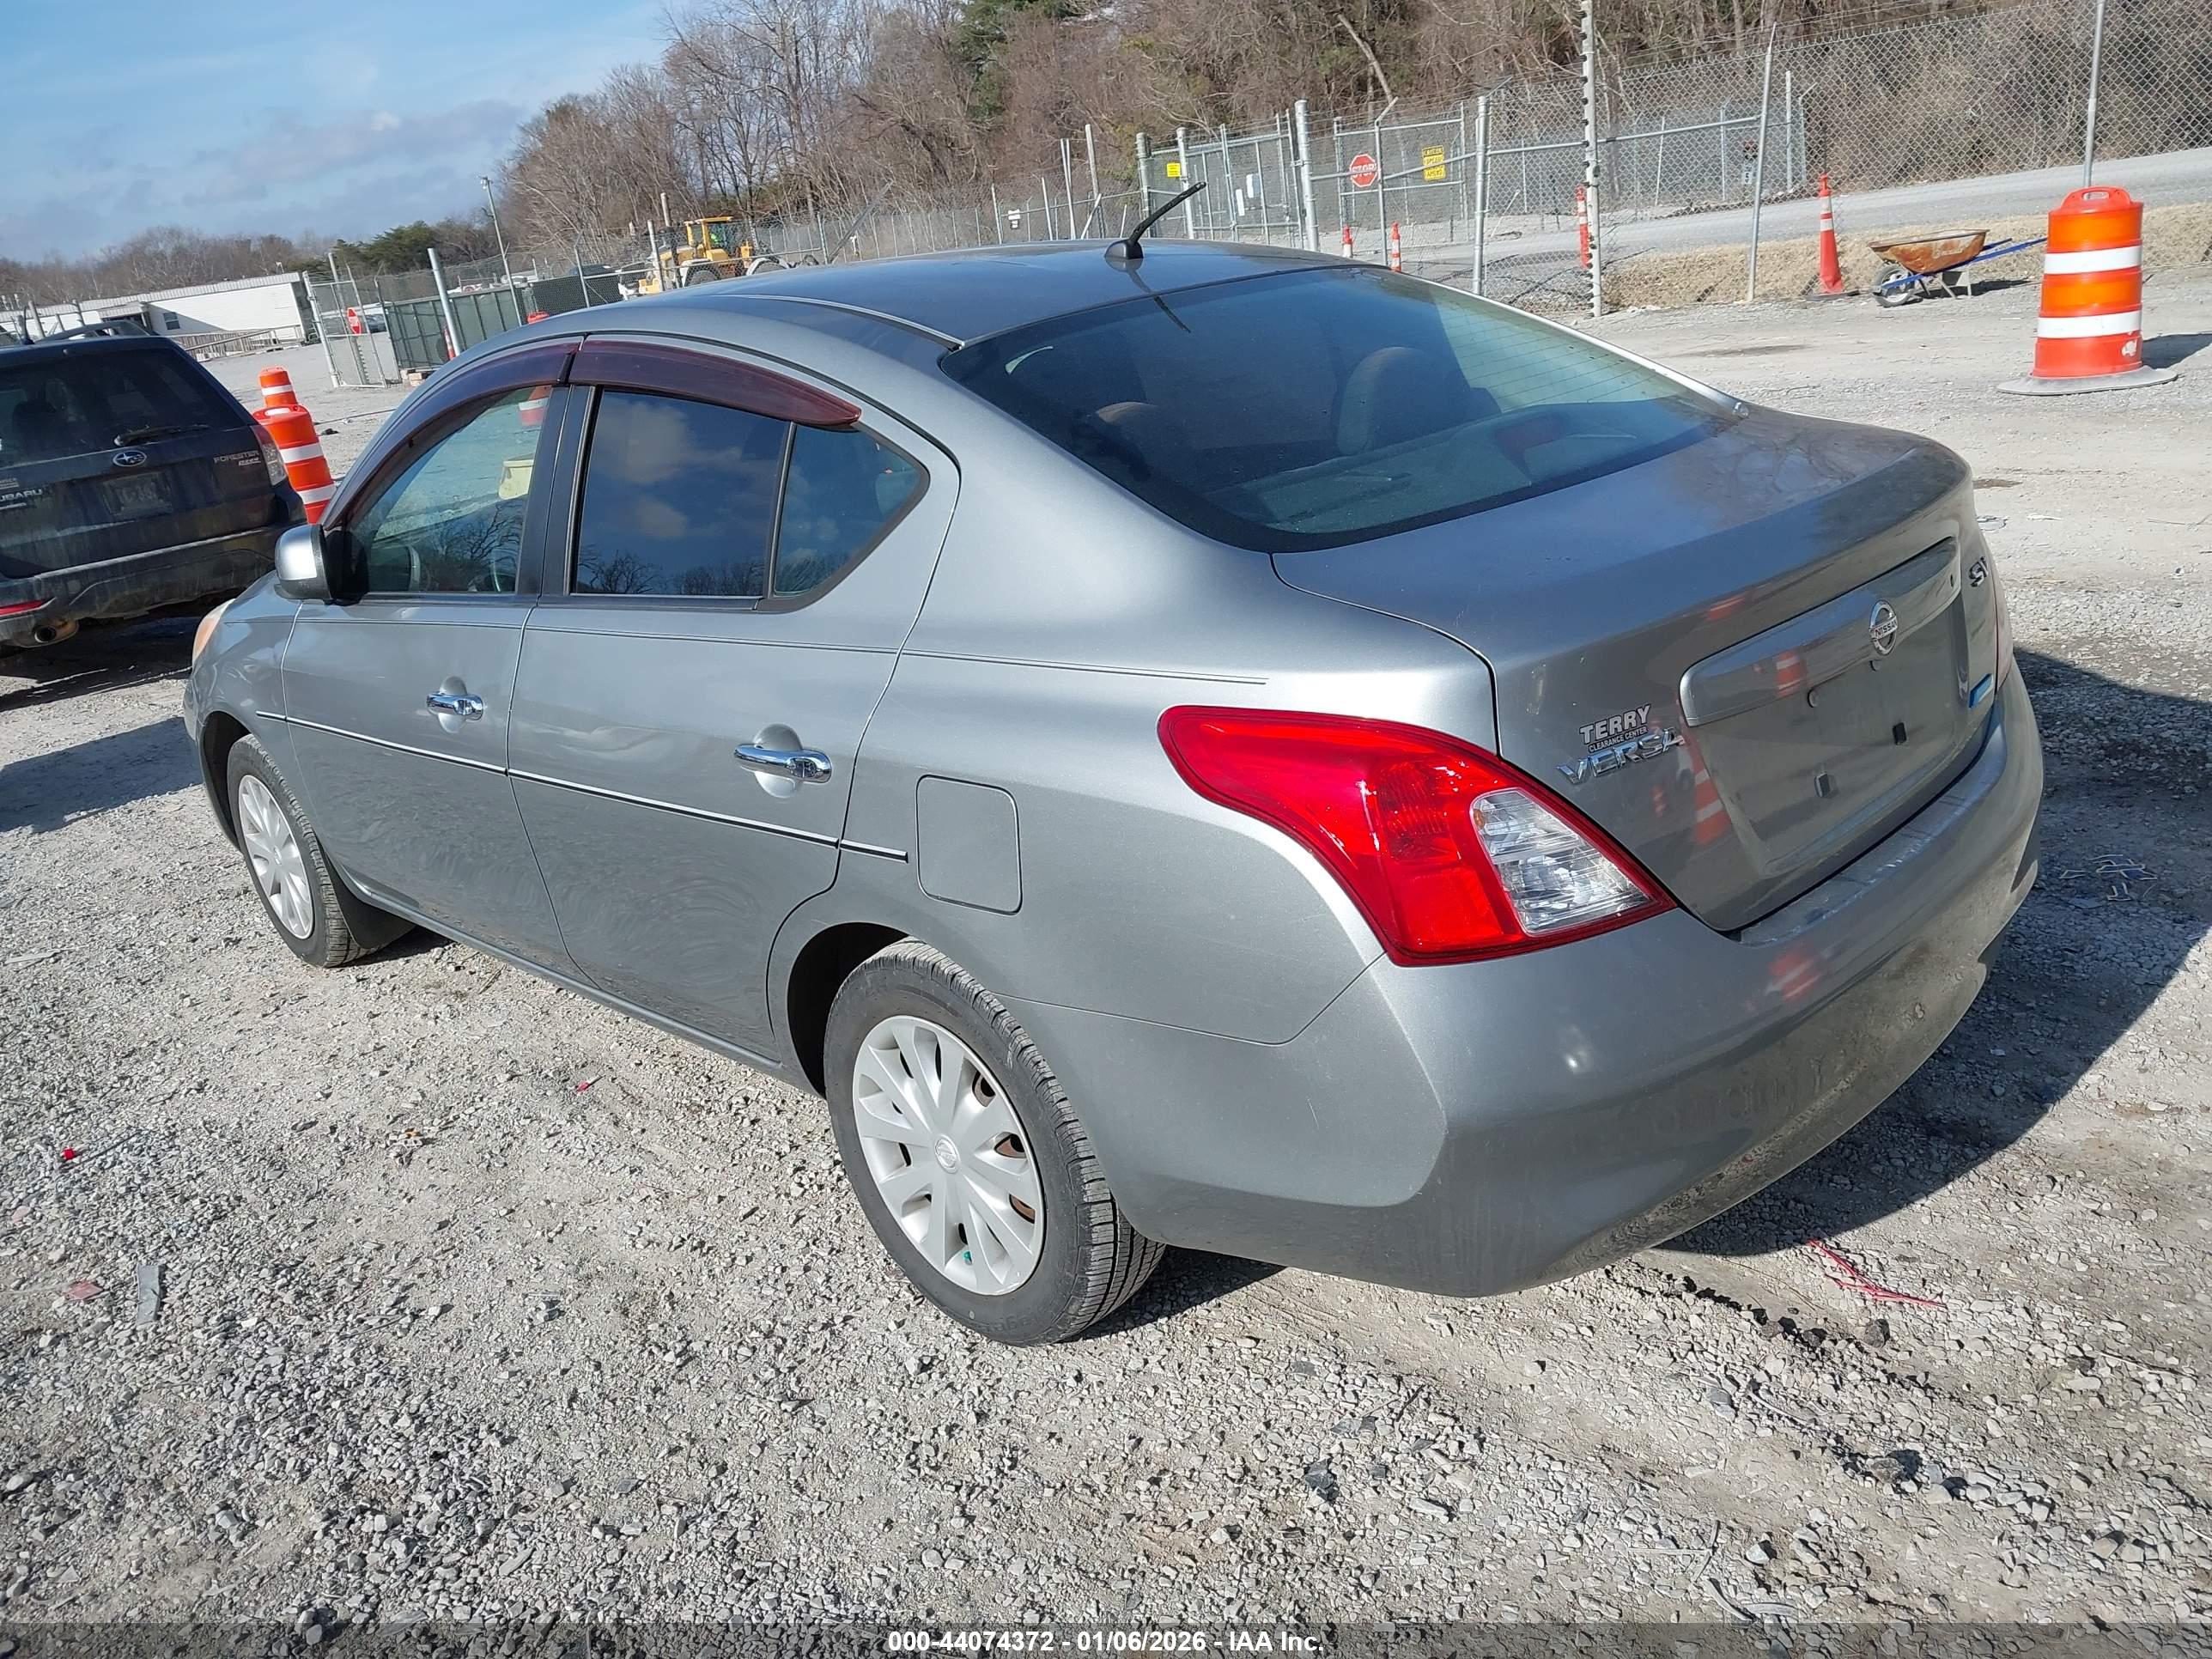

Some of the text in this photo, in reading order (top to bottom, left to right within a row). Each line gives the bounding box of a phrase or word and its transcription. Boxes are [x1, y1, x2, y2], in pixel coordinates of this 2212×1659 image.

[1352, 164, 1376, 178] STOP
[212, 450, 260, 464] FORESTER
[0, 489, 44, 502] UBARU
[1579, 704, 1651, 744] TERRY
[1588, 725, 1649, 753] CLEARANCE CENTER
[1555, 727, 1686, 785] VERSA
